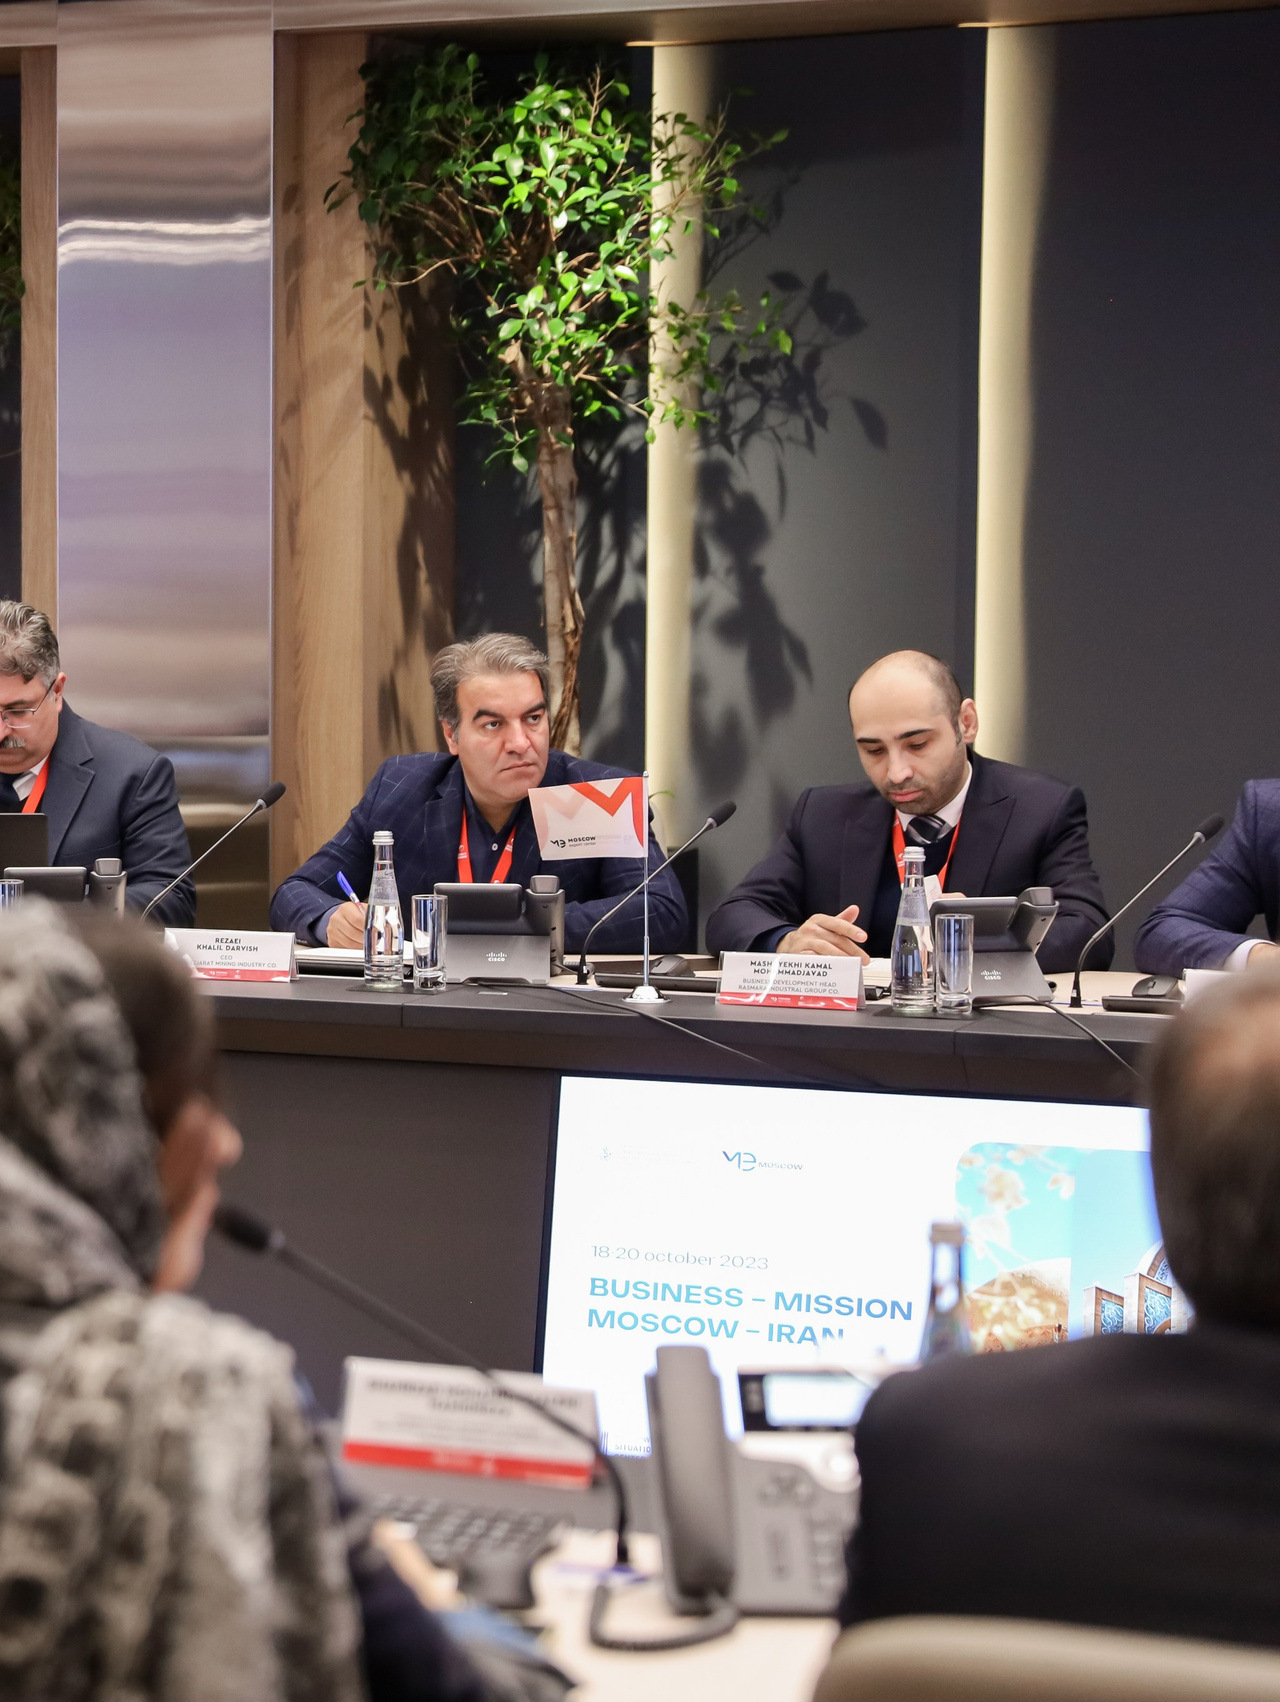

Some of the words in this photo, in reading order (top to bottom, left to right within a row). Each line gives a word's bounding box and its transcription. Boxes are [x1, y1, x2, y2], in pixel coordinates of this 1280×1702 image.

[750, 960, 802, 968] MASHYEKHI
[804, 962, 832, 970] KAMAL
[753, 968, 828, 977] MOHMMADJAVAD
[758, 1161, 803, 1170] MOSCOW
[644, 1251, 716, 1266] october
[720, 1254, 769, 1270] 2023
[589, 1277, 743, 1308] BUSINESS
[774, 1291, 913, 1321] MISSION
[587, 1308, 739, 1339] MOSCOW
[768, 1323, 844, 1345] IRAN
